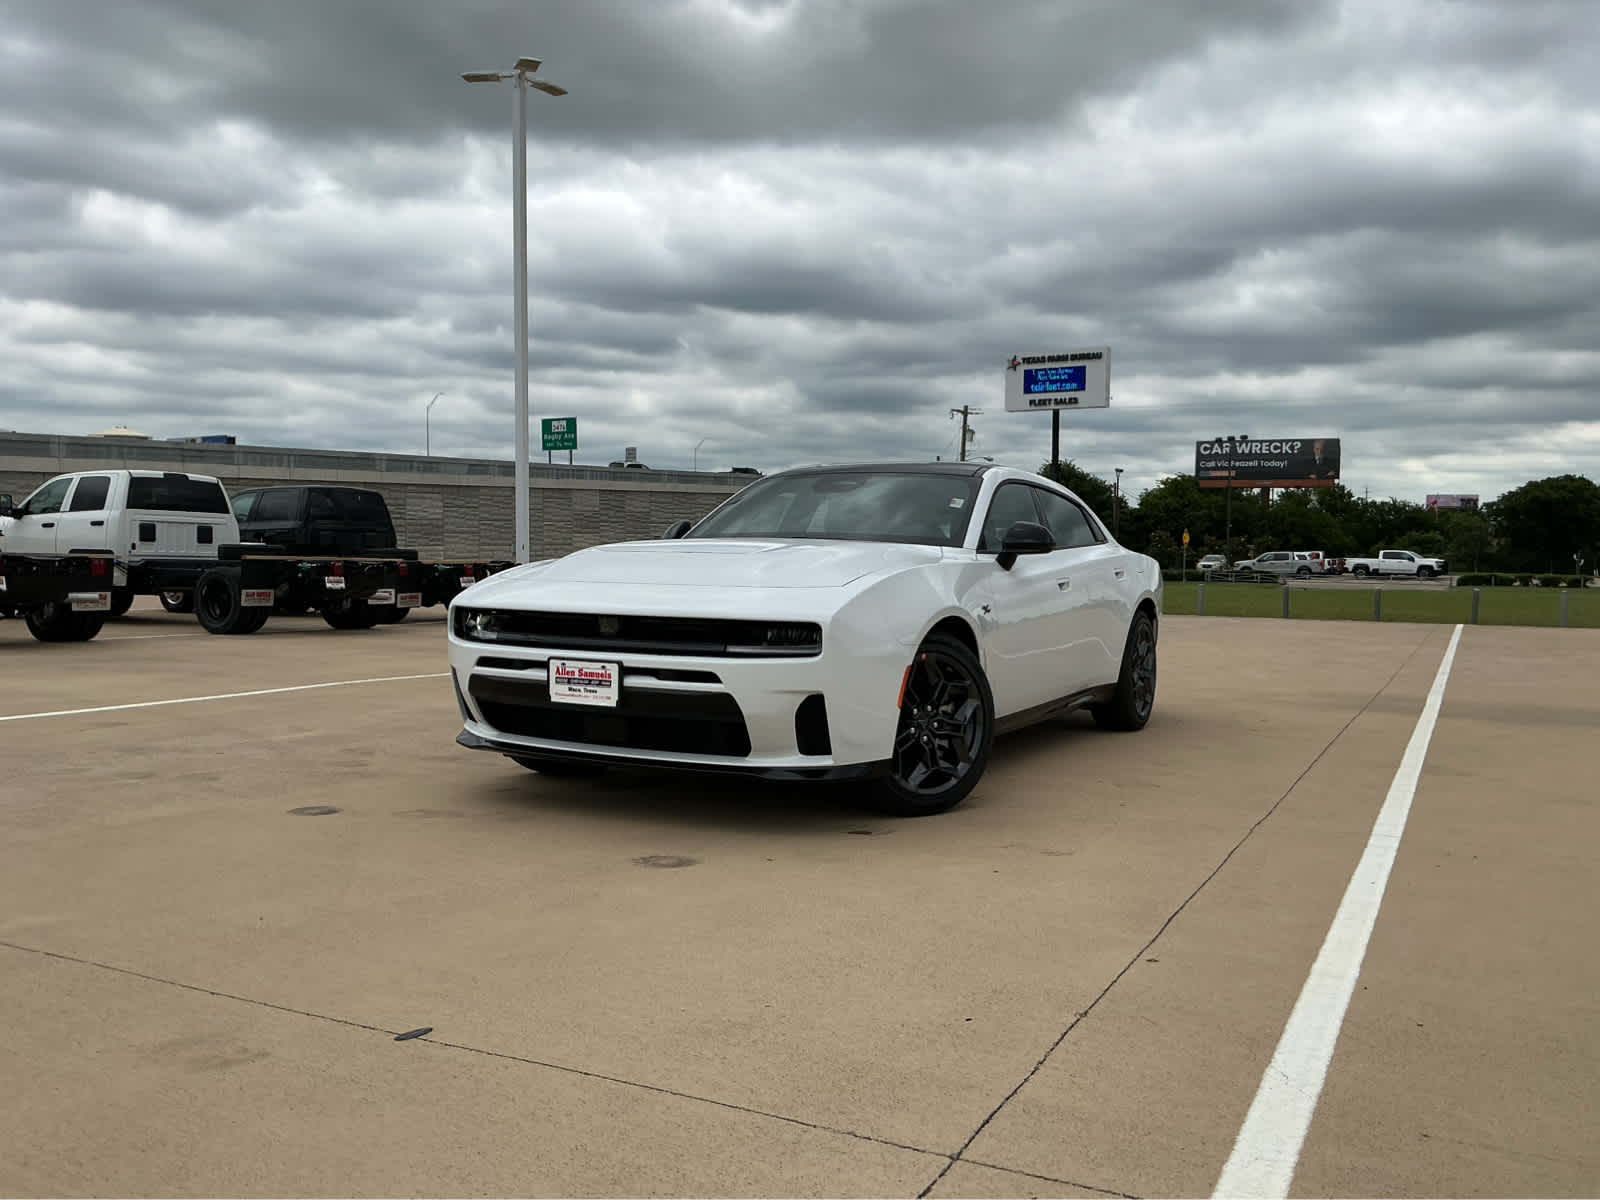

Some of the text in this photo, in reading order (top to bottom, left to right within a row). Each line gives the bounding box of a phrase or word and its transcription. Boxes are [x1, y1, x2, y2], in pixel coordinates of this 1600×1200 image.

[1029, 397, 1079, 407] FLEET SALES
[1200, 441, 1302, 455] CAR WRECK?
[1200, 460, 1215, 468] Call
[1260, 460, 1288, 469] Today!
[555, 665, 612, 680] Allen Samuels
